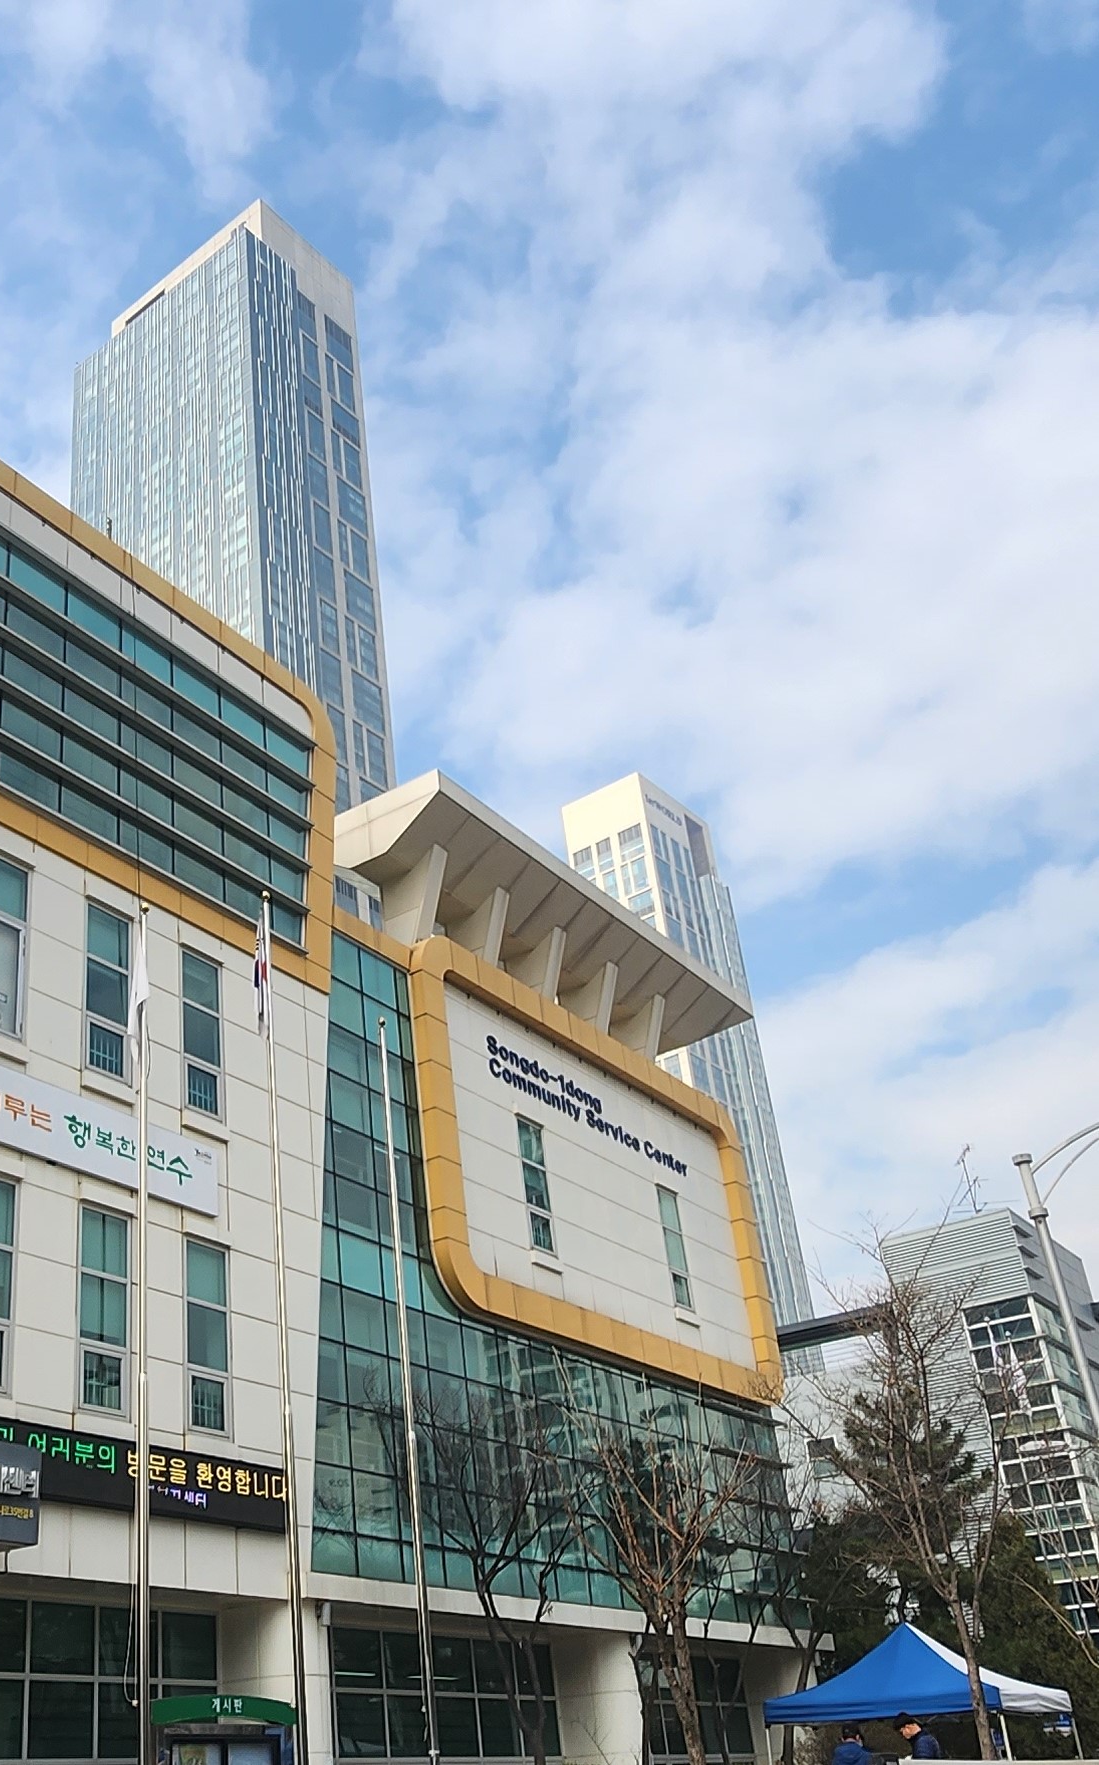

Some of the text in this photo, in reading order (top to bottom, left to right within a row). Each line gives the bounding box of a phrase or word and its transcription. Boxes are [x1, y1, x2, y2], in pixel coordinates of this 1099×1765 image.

[486, 1035, 602, 1114] Songdo-1dong
[63, 1114, 137, 1162] 행복한
[147, 1144, 194, 1186] 연수
[489, 1058, 688, 1176] Community Service Center
[196, 1463, 288, 1502] 환영합니다
[211, 1698, 243, 1714] 게시판
